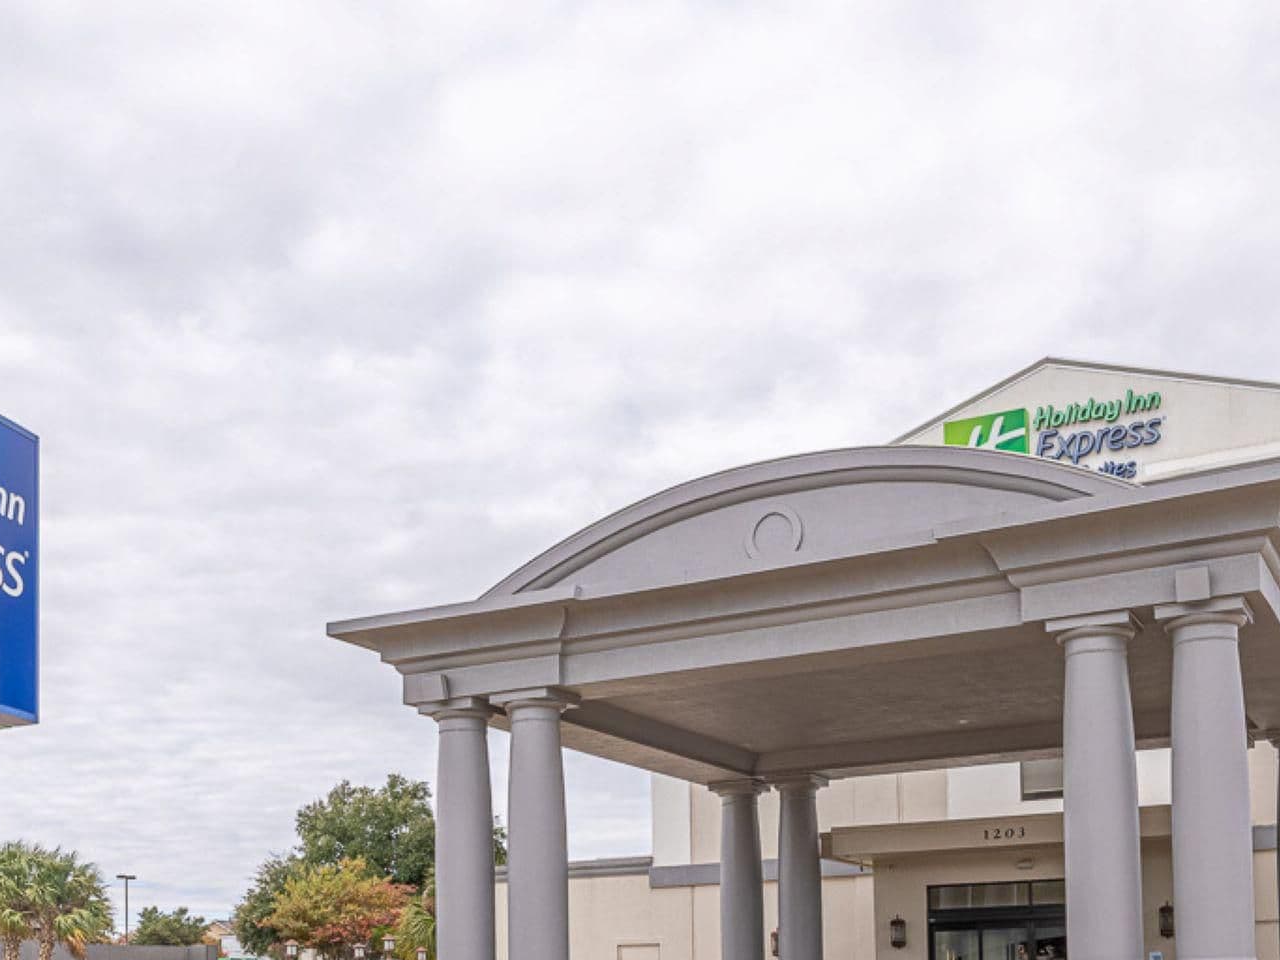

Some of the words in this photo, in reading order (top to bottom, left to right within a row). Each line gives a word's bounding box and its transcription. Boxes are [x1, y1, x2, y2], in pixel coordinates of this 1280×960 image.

[1033, 397, 1121, 430] Holiday
[1125, 389, 1161, 414] Inn
[1036, 417, 1161, 464] Express
[1082, 460, 1137, 479] ites
[983, 826, 1025, 840] 1203
